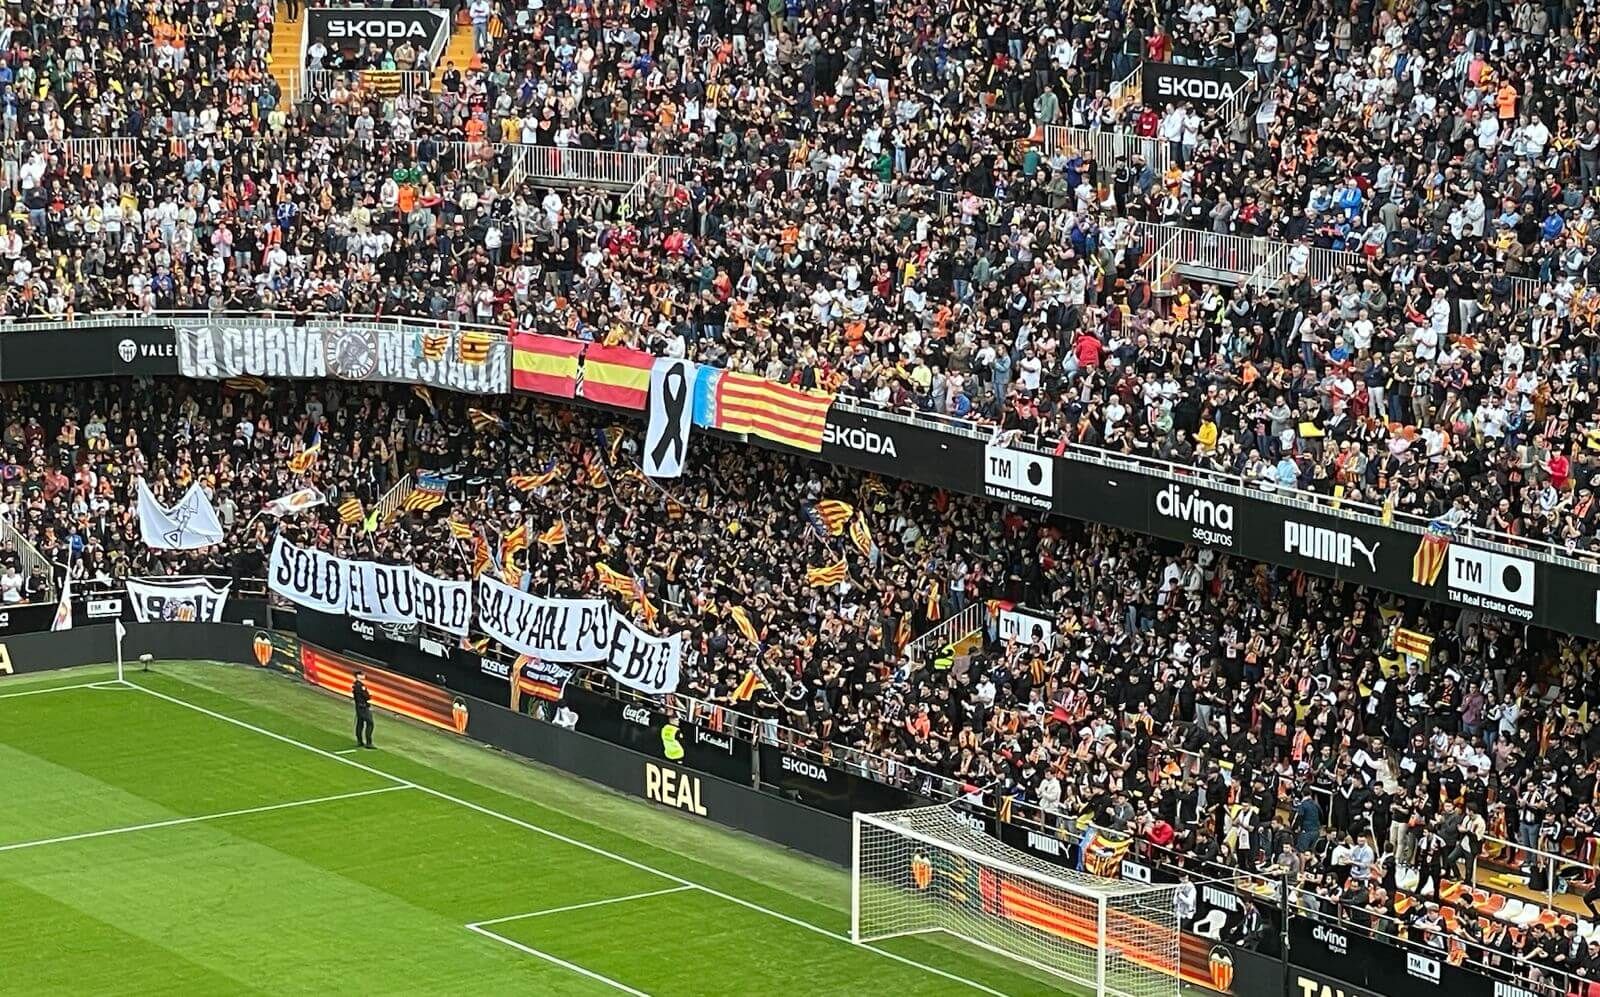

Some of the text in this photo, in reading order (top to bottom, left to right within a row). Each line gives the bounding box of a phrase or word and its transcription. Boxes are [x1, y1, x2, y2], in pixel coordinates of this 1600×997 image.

[327, 20, 427, 37] SKODA
[1158, 76, 1235, 101] SKODA
[140, 343, 178, 357] VALE
[179, 327, 220, 377] LA
[222, 326, 327, 377] CURVA
[822, 423, 897, 458] SKODA
[989, 456, 1012, 480] TM
[1156, 483, 1233, 531] divina
[1192, 525, 1233, 547] seguros
[1455, 557, 1482, 584] TM
[276, 541, 341, 605] SOLO
[349, 564, 372, 614] EL
[374, 567, 468, 629] PUEBLO
[1447, 589, 1534, 621] TM Real Estate Group
[782, 757, 828, 782] SKODA
[646, 762, 708, 816] REAL
[1312, 925, 1347, 948] divina
[1409, 957, 1421, 968] TM
